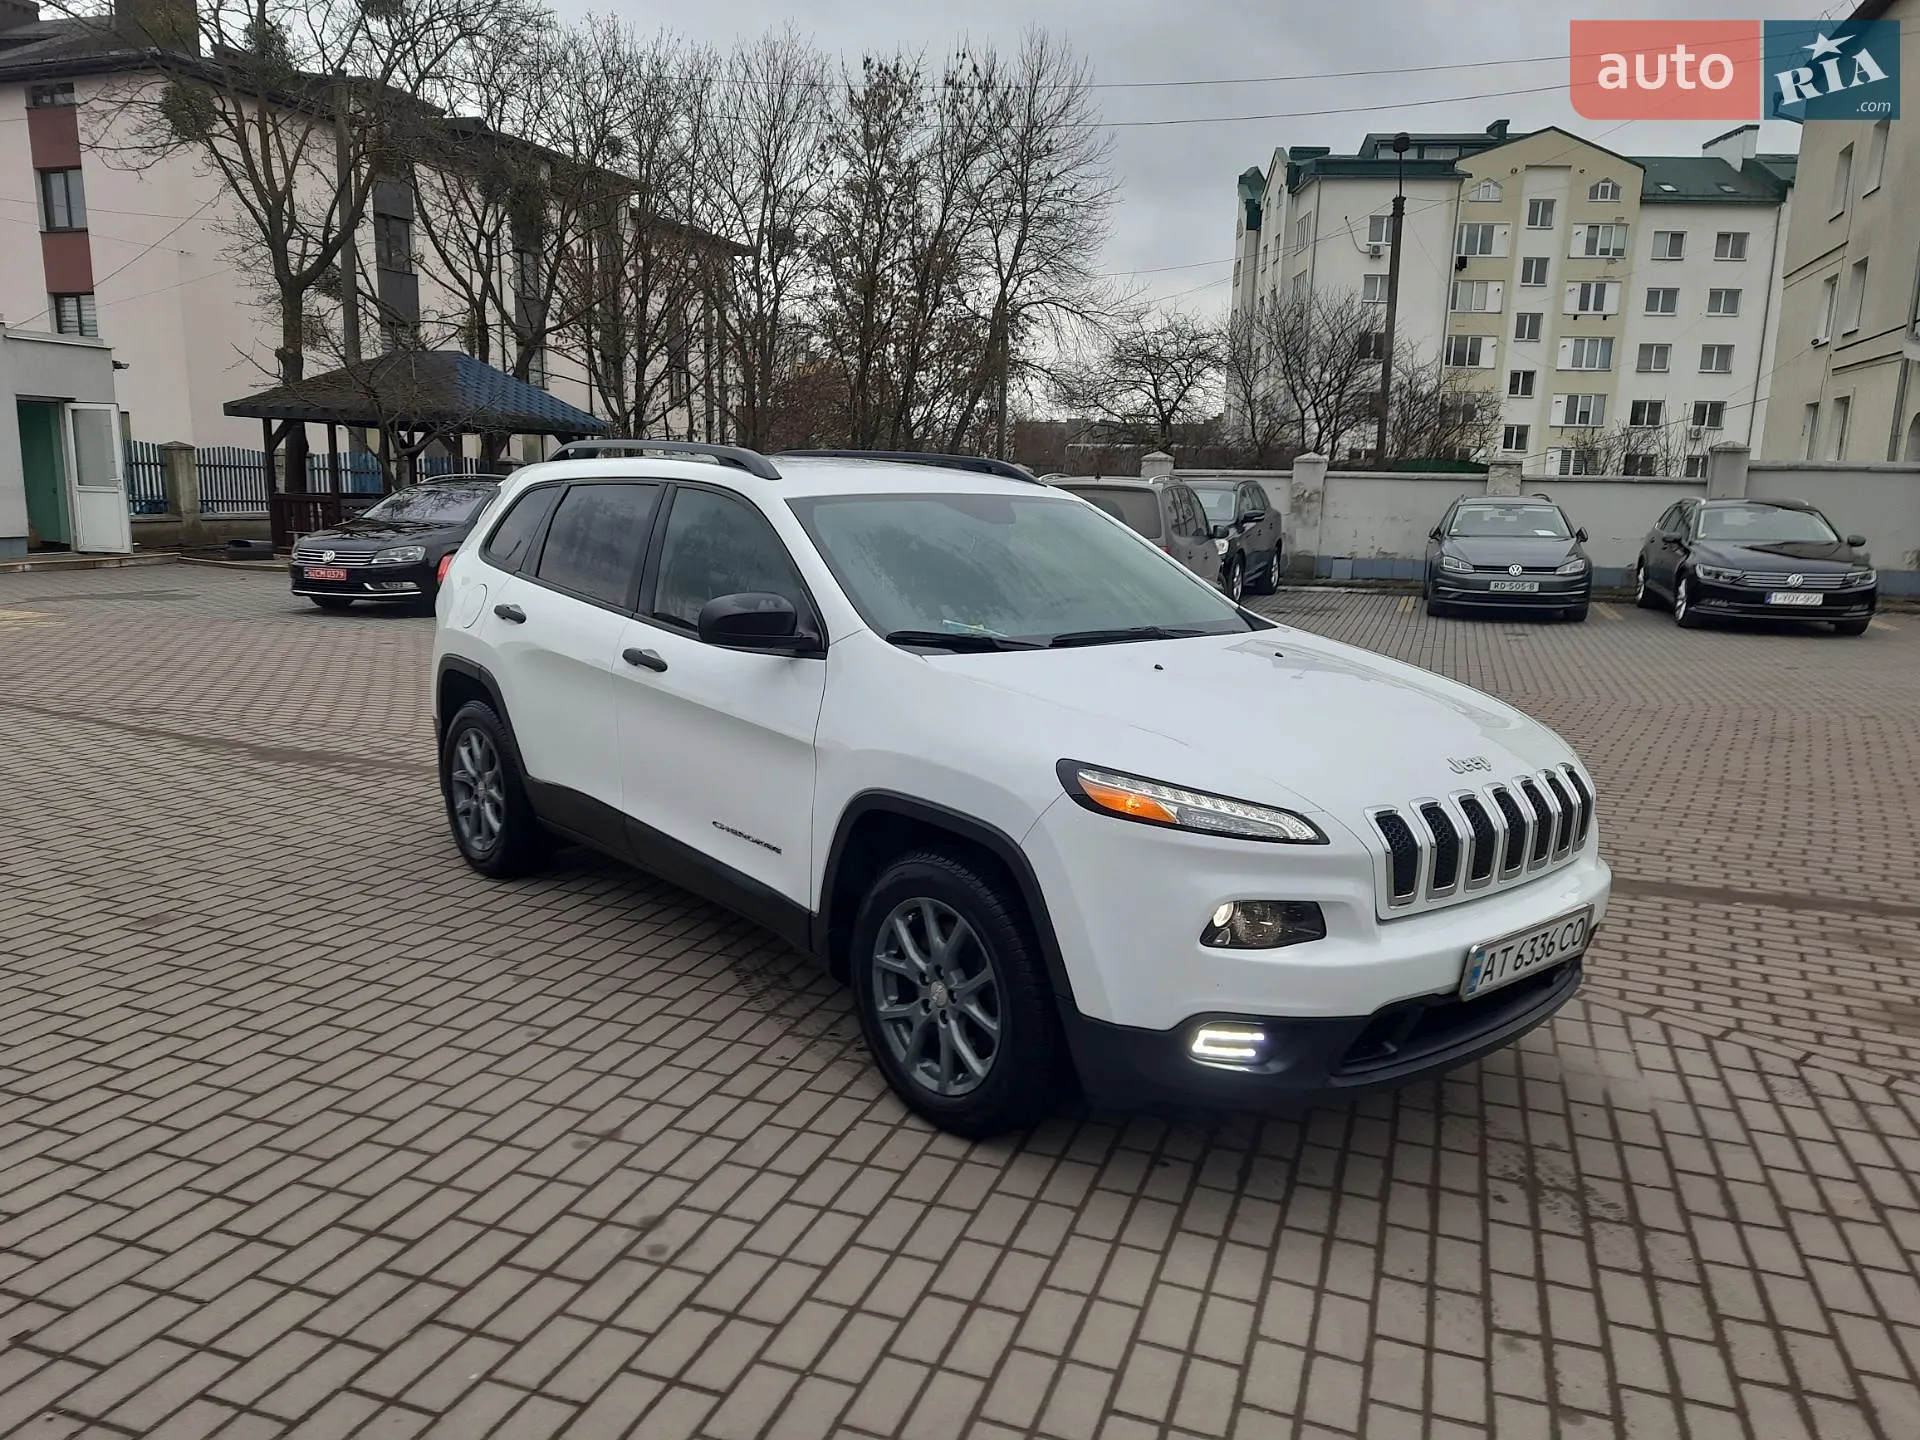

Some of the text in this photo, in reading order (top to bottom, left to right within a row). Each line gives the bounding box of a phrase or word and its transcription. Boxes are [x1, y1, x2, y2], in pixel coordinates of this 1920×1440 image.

[1446, 756, 1492, 774] Jeep
[1480, 917, 1585, 985] AT 6336 CO
